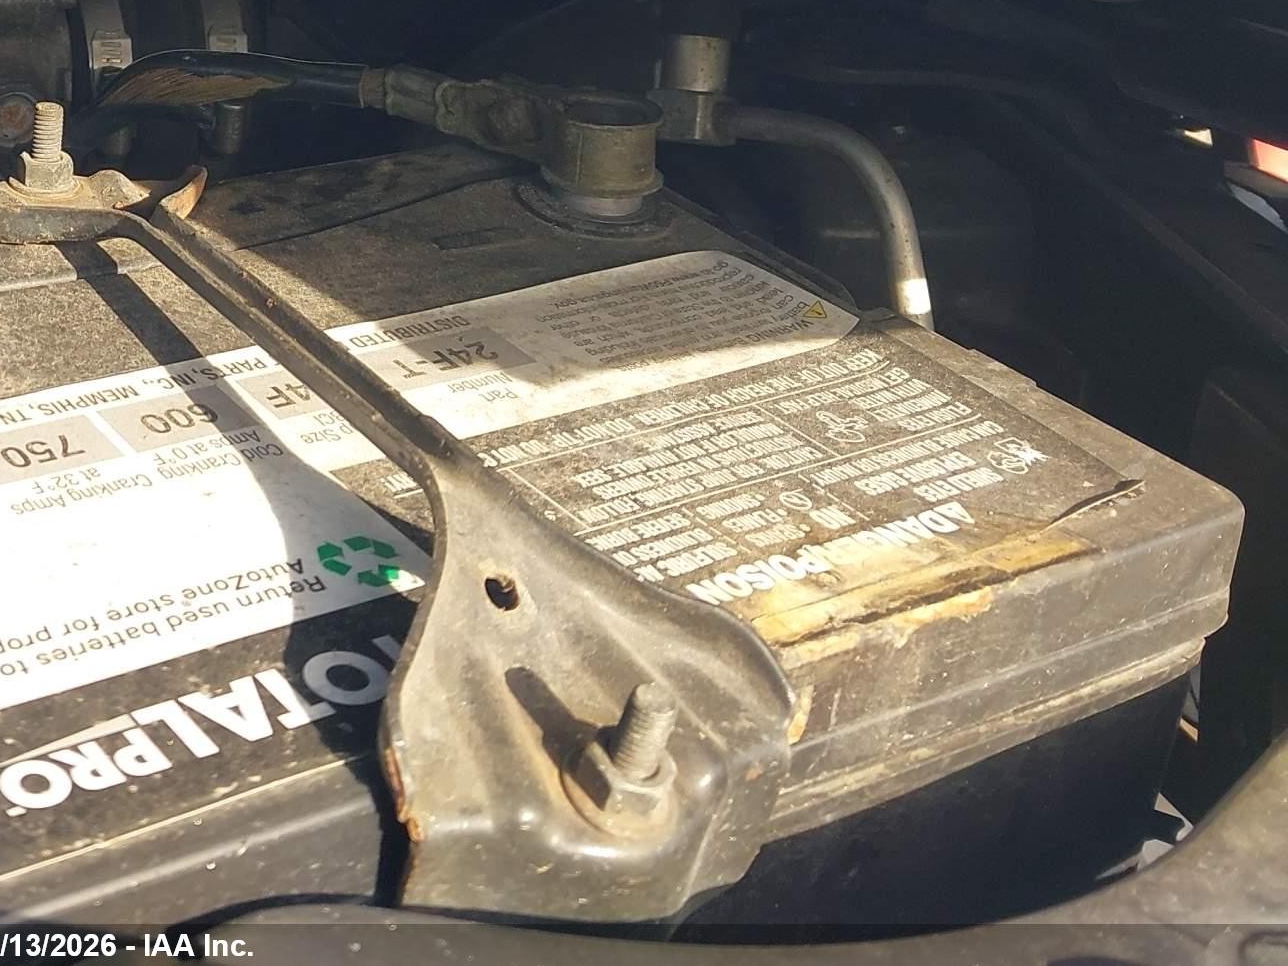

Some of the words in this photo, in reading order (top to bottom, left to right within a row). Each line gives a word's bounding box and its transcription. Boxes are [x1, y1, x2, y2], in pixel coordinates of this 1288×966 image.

[349, 316, 470, 348] DISTRIBUTED
[192, 358, 267, 381] PARTS,
[393, 341, 498, 378] 24F-T
[448, 371, 512, 396] Number
[477, 387, 518, 403] Part
[29, 386, 139, 416] MEMPHIS,
[267, 384, 311, 409] 4F
[141, 405, 218, 434] 600
[897, 416, 936, 431] EYES
[969, 421, 1004, 437] CAN
[210, 430, 261, 448] Amps
[300, 429, 342, 444] Size
[933, 429, 981, 449] CAUSE
[1, 436, 85, 468] 750
[188, 443, 209, 456] at
[240, 444, 283, 462] Cold
[80, 468, 101, 482] at
[157, 454, 242, 479] Cranking
[852, 458, 881, 473] OR
[896, 452, 976, 482] EXPLOSIVE
[67, 474, 153, 501] Cranking
[855, 472, 908, 496] GASES
[913, 481, 960, 502] EYES
[948, 468, 1003, 491] SHIELD
[11, 495, 67, 515] Amps
[697, 494, 760, 520] SMOKING
[632, 513, 691, 538] SEVERE
[723, 510, 783, 533] FLAMES
[809, 506, 855, 530] NO
[237, 576, 326, 607] Return
[107, 595, 175, 621] store
[166, 602, 230, 632] used
[64, 616, 100, 636] for
[37, 623, 160, 665] batteries
[0, 660, 29, 676] to
